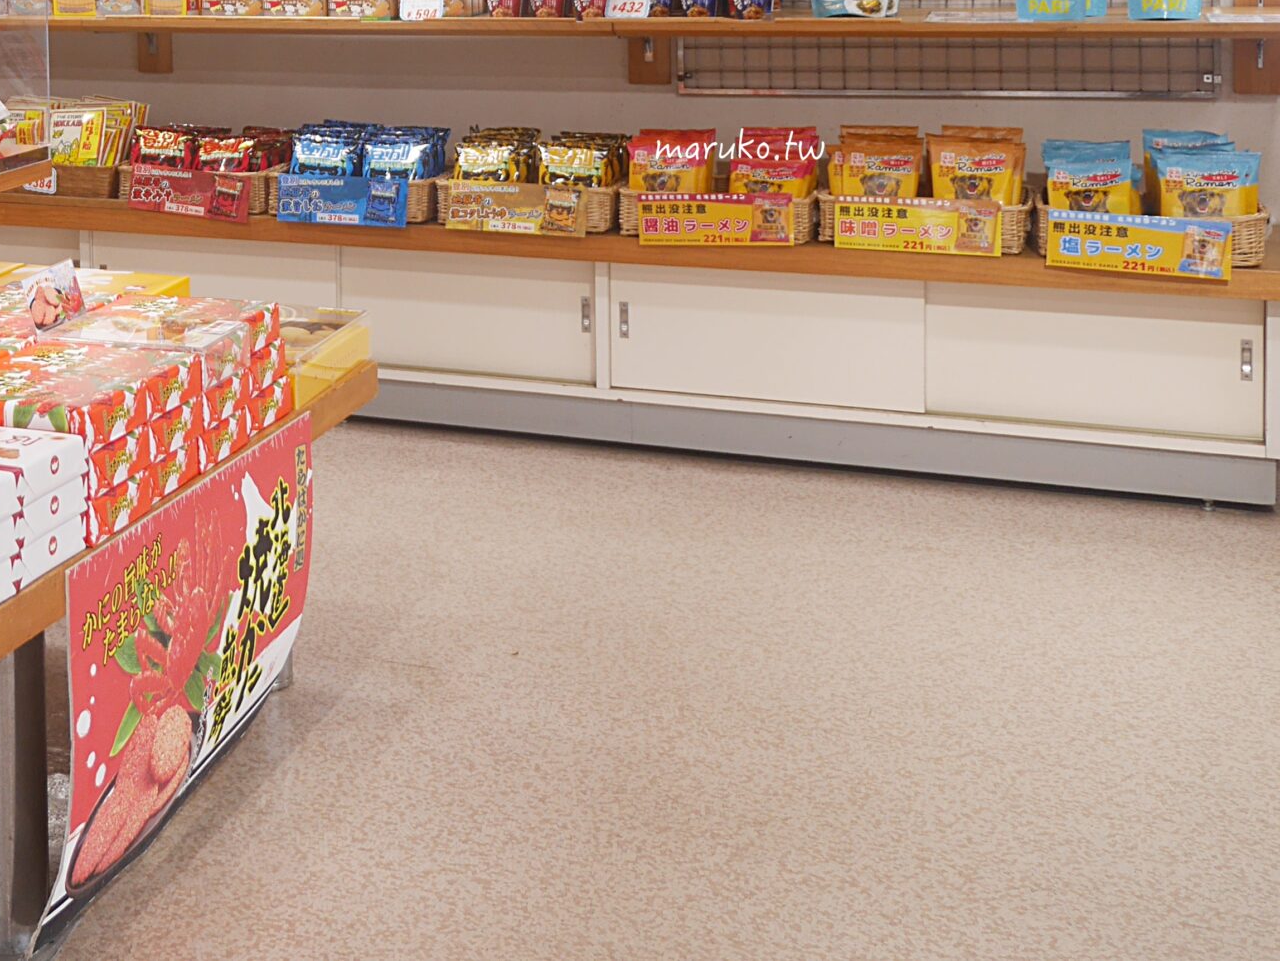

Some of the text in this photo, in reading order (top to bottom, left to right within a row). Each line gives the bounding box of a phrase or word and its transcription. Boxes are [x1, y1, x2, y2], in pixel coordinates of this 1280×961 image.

[611, 0, 645, 15] ¥432
[865, 161, 913, 174] Ramen
[956, 161, 1004, 175] Ramen
[1185, 177, 1238, 189] Ramen
[641, 203, 707, 215] 熊出没注意
[839, 205, 909, 219] 熊出没注意
[643, 217, 750, 234] 醤油ラーメン
[839, 219, 953, 240] 味噌ラーメン
[1052, 221, 1129, 238] 熊出没注意
[1060, 236, 1164, 259] 塩ラーメン
[270, 474, 291, 632] 北海道
[82, 531, 163, 652] かにの旨味が
[236, 515, 275, 716] 焼かに
